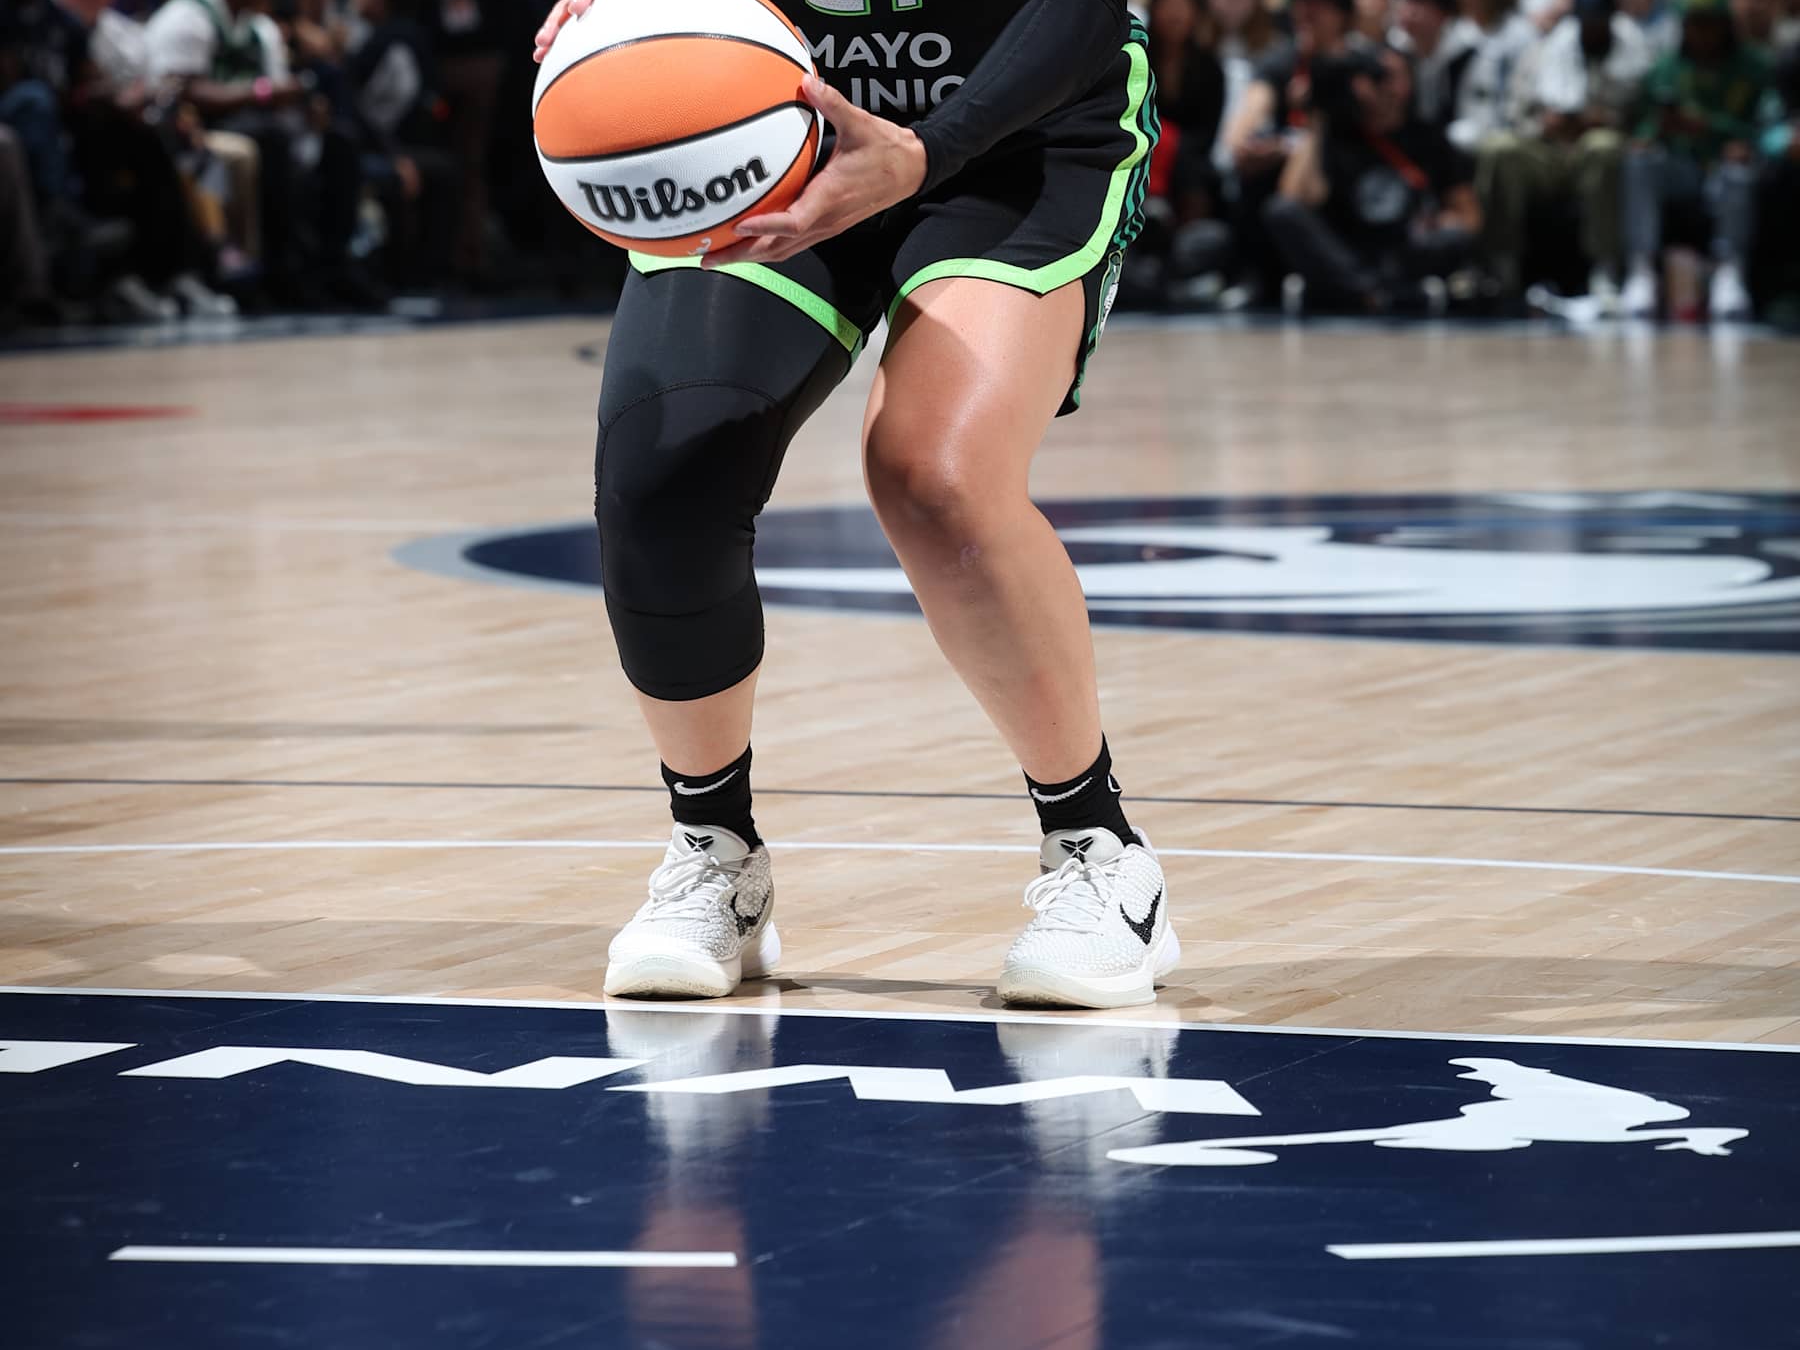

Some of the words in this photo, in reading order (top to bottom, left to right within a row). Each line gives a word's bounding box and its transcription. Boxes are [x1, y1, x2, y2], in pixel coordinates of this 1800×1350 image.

[796, 30, 952, 70] MAYO
[818, 74, 968, 114] INIC
[577, 156, 770, 223] Wilson
